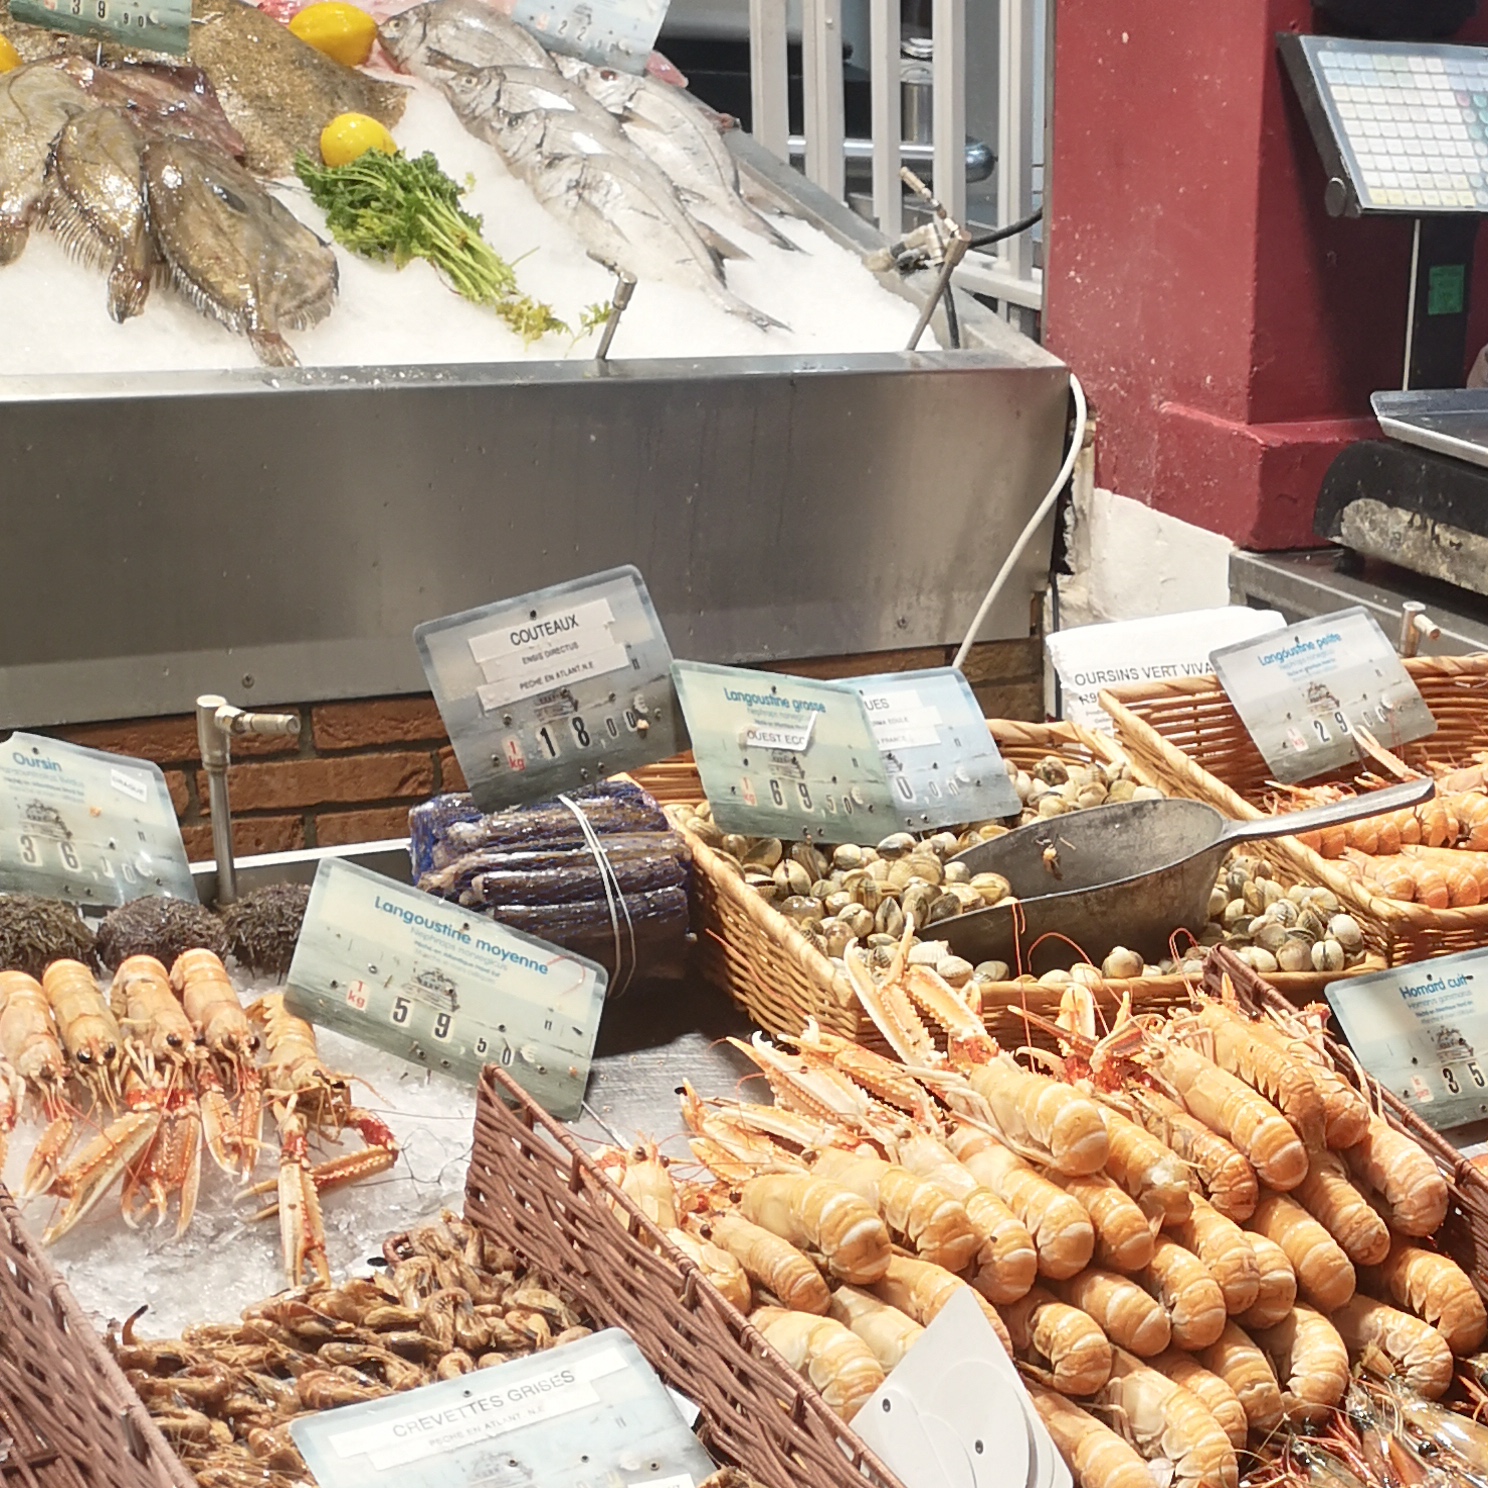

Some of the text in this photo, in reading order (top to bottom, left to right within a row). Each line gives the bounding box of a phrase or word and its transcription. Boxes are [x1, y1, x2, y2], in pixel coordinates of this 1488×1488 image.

[510, 615, 579, 646] COUTEAUX
[1257, 641, 1314, 666] Langoustine
[544, 672, 555, 683] EN
[1075, 662, 1215, 686] OURSINS VERT VIVA
[723, 687, 790, 709] Langoustine
[793, 698, 827, 714] grosse
[864, 698, 890, 711] UES
[747, 730, 783, 744] OUEST
[13, 752, 62, 772] Oursin
[374, 895, 549, 975] Langoustine moyenne
[1399, 974, 1468, 999] Homard cuit
[393, 1370, 576, 1438] CREVETTES GRISES
[428, 1431, 464, 1448] PECHE
[466, 1426, 481, 1438] EN
